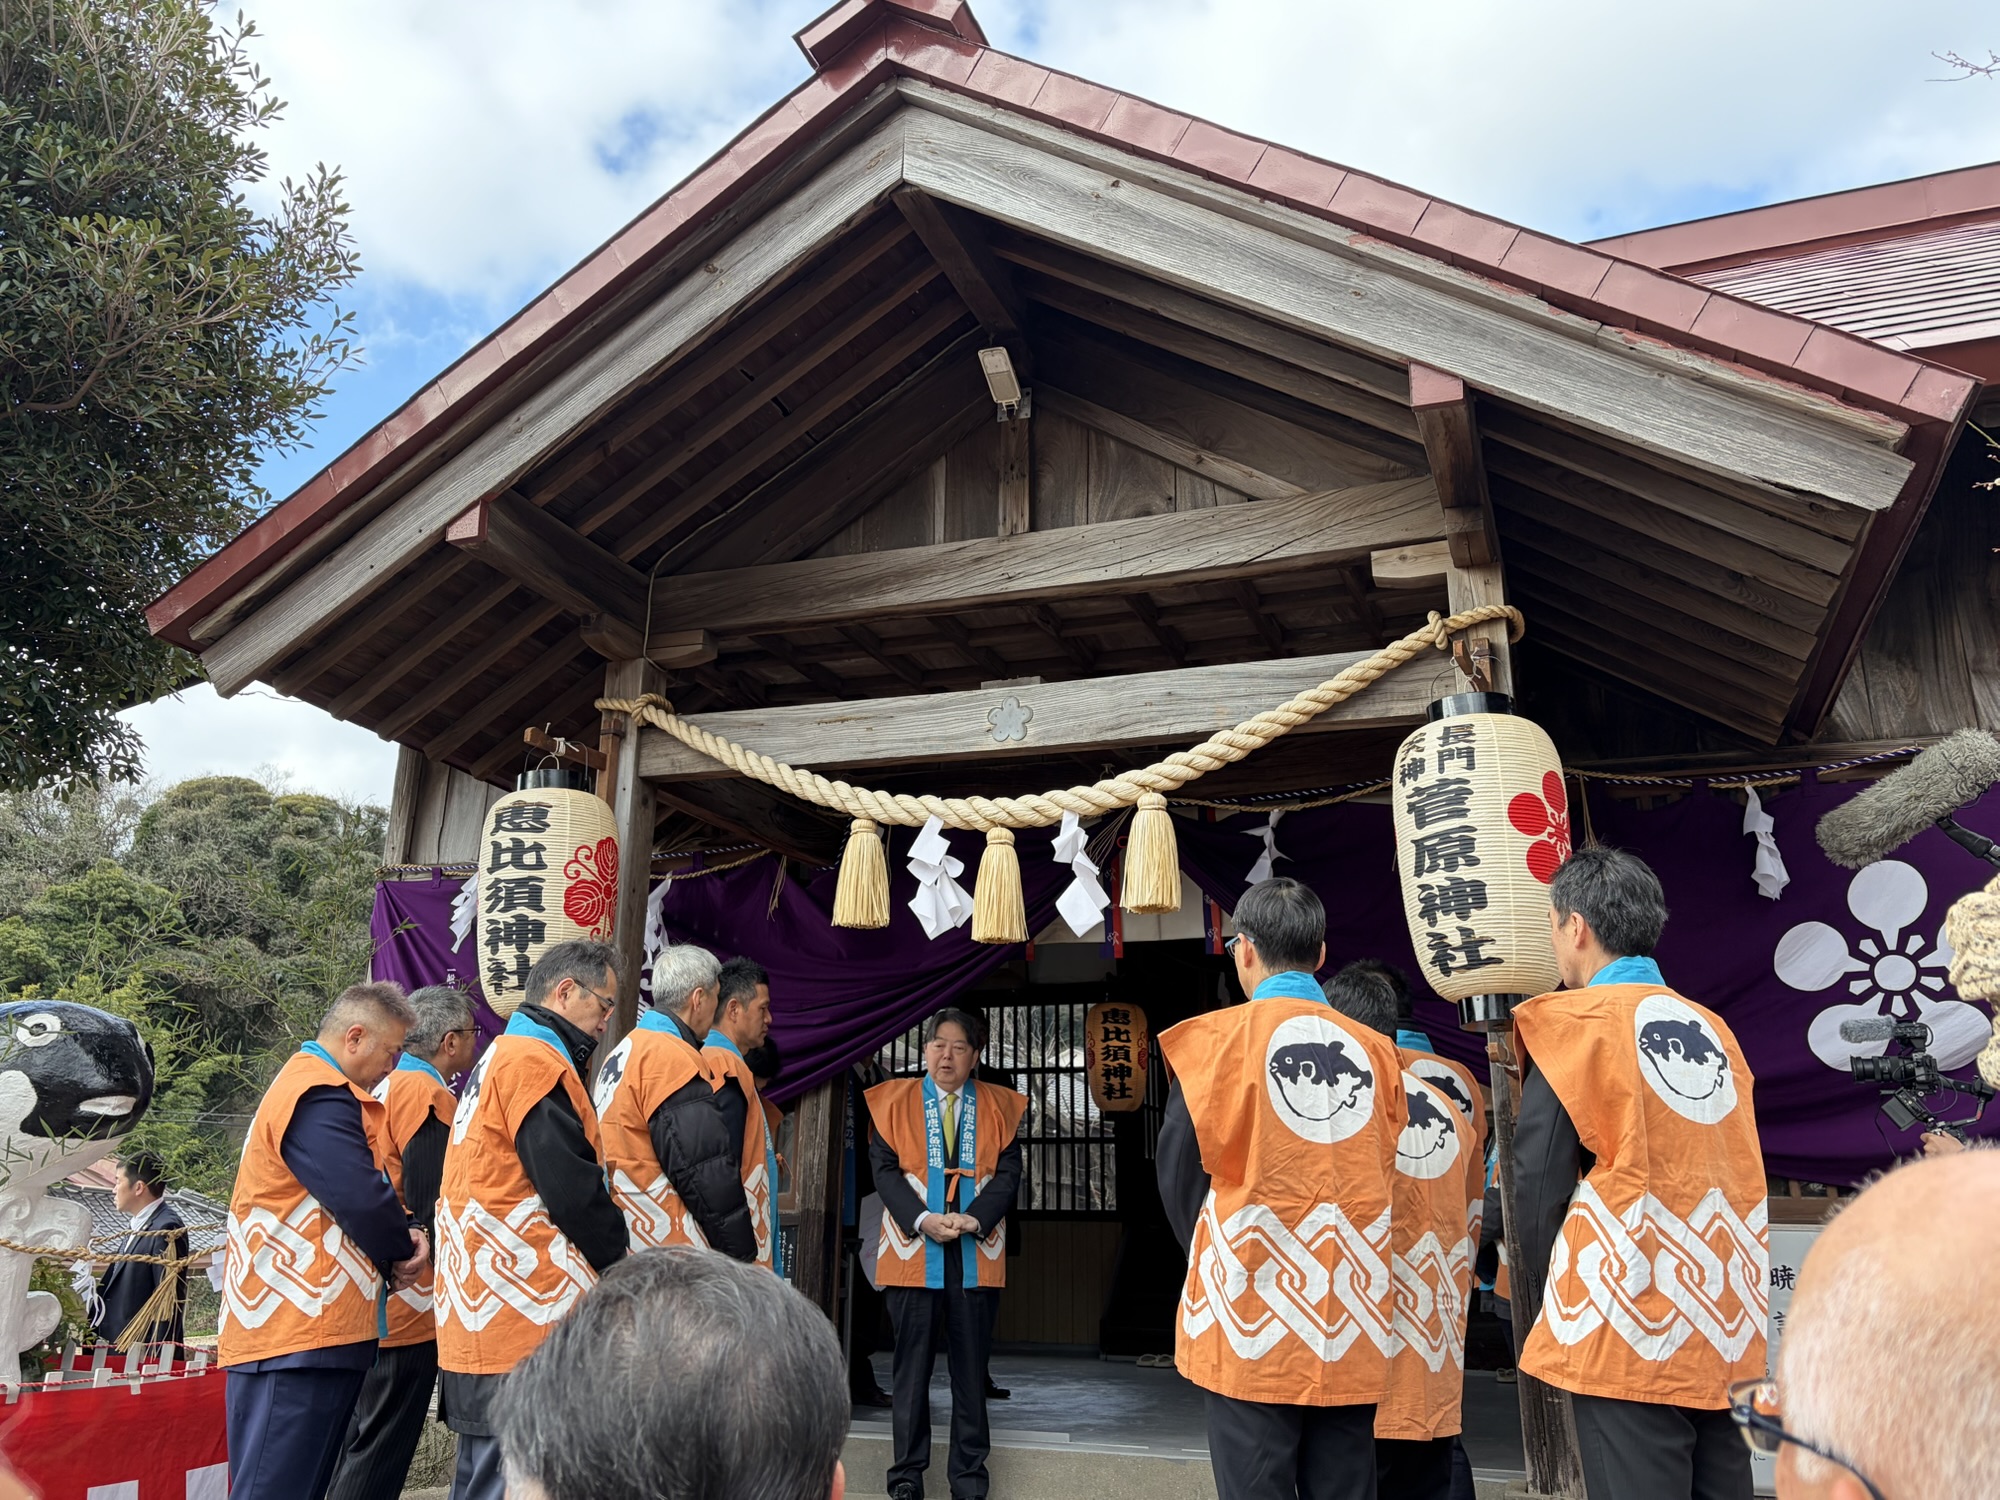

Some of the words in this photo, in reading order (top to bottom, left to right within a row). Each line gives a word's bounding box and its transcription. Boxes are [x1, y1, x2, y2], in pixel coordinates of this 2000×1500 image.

[484, 799, 553, 996] 恵比須神社
[1100, 1007, 1133, 1101] 恵比須神社
[924, 1098, 944, 1169] 下関唐戸魚市場
